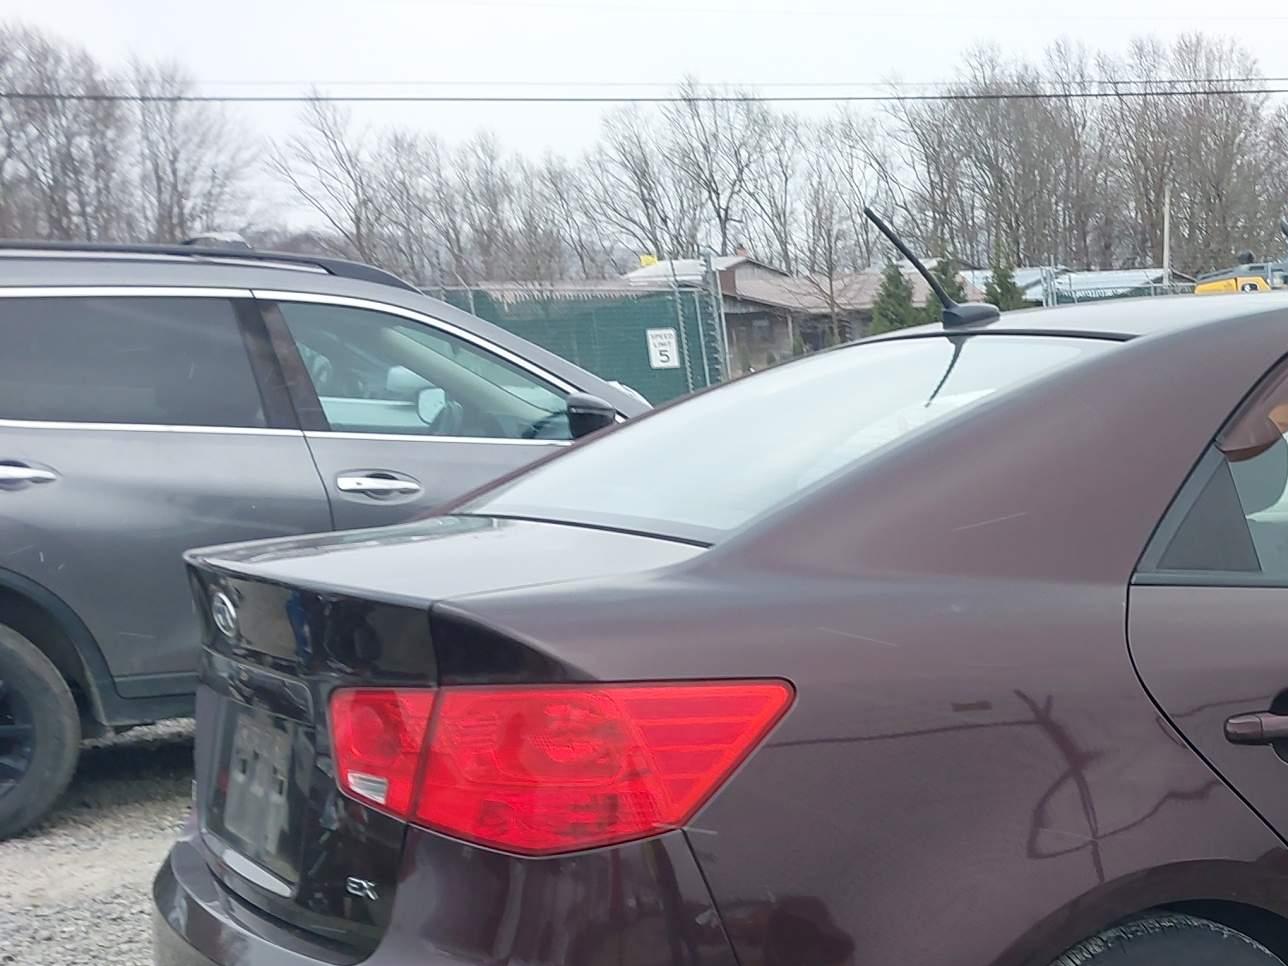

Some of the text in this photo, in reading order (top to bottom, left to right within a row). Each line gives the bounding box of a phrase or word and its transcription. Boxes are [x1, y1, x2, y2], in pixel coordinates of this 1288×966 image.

[650, 332, 674, 341] SPEED
[652, 341, 672, 349] LIMIT
[659, 349, 671, 364] 5
[347, 876, 379, 901] EX
